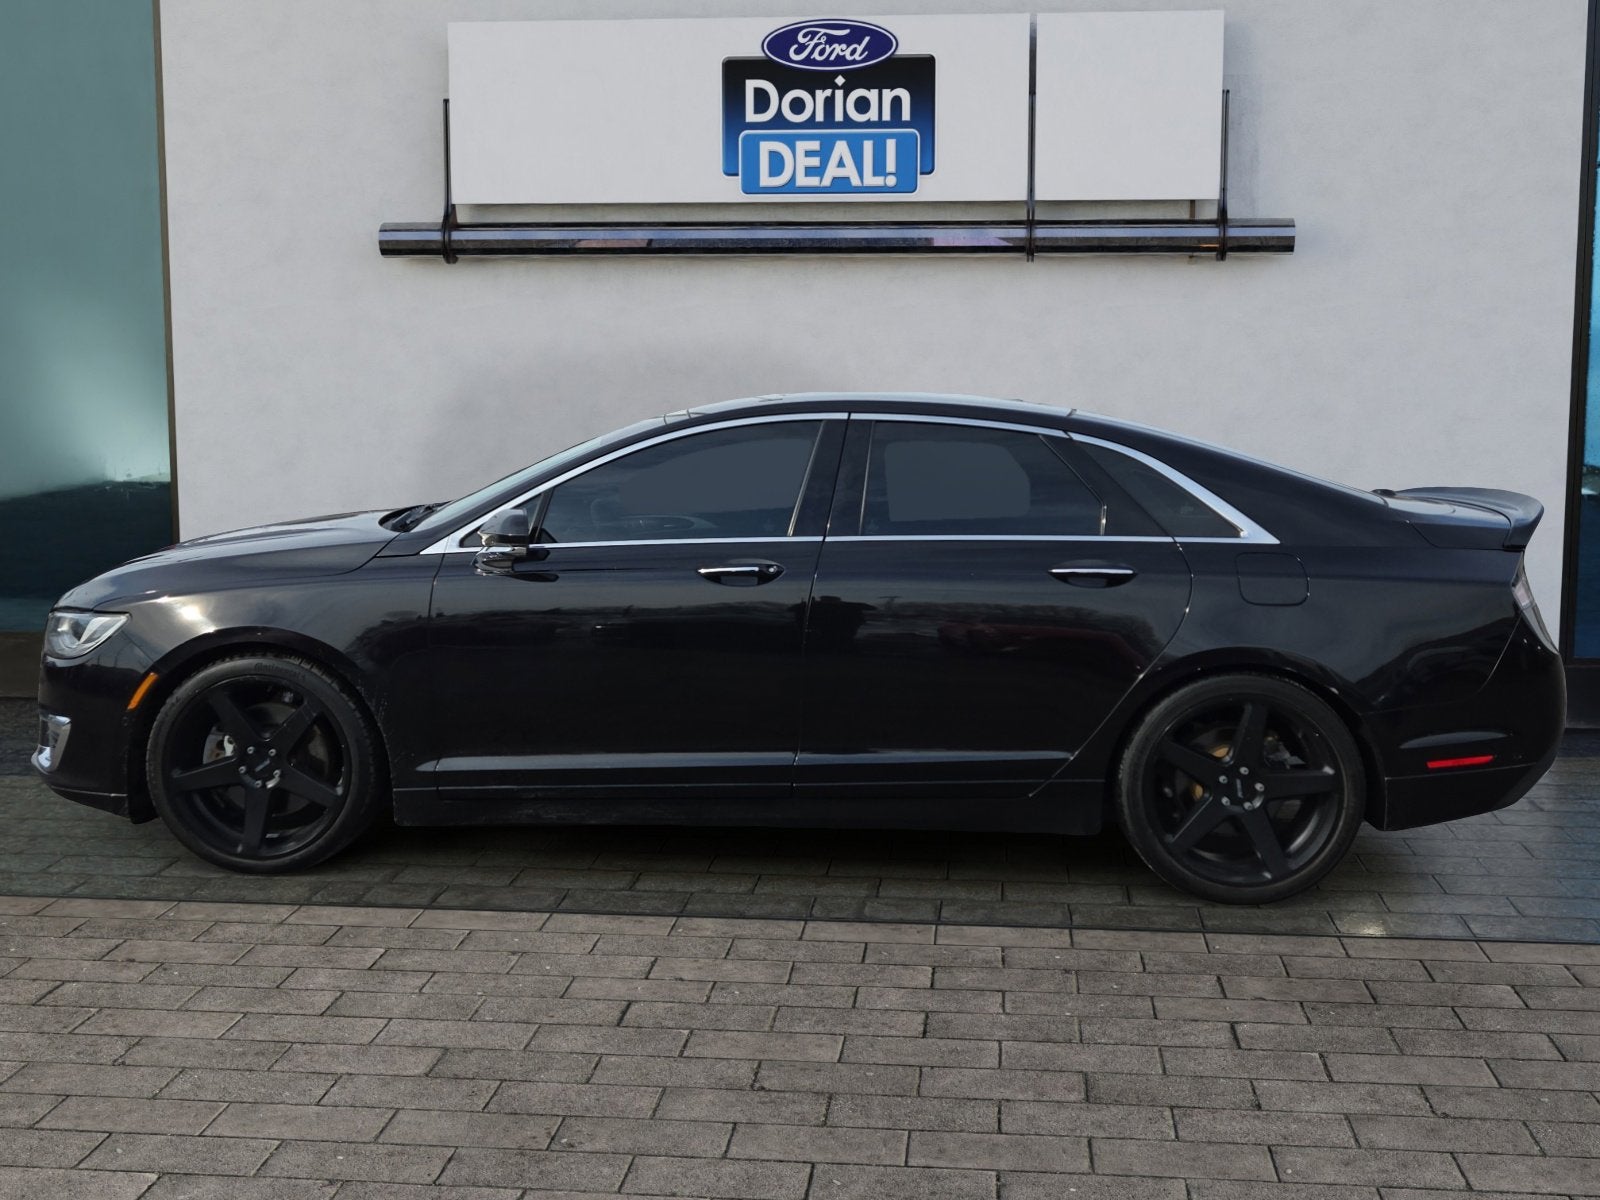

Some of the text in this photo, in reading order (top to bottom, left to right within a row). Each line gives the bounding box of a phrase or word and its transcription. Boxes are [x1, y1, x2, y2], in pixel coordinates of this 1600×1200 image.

[789, 28, 871, 61] Ford
[745, 75, 911, 123] Dorian
[759, 139, 898, 188] DEAL!
